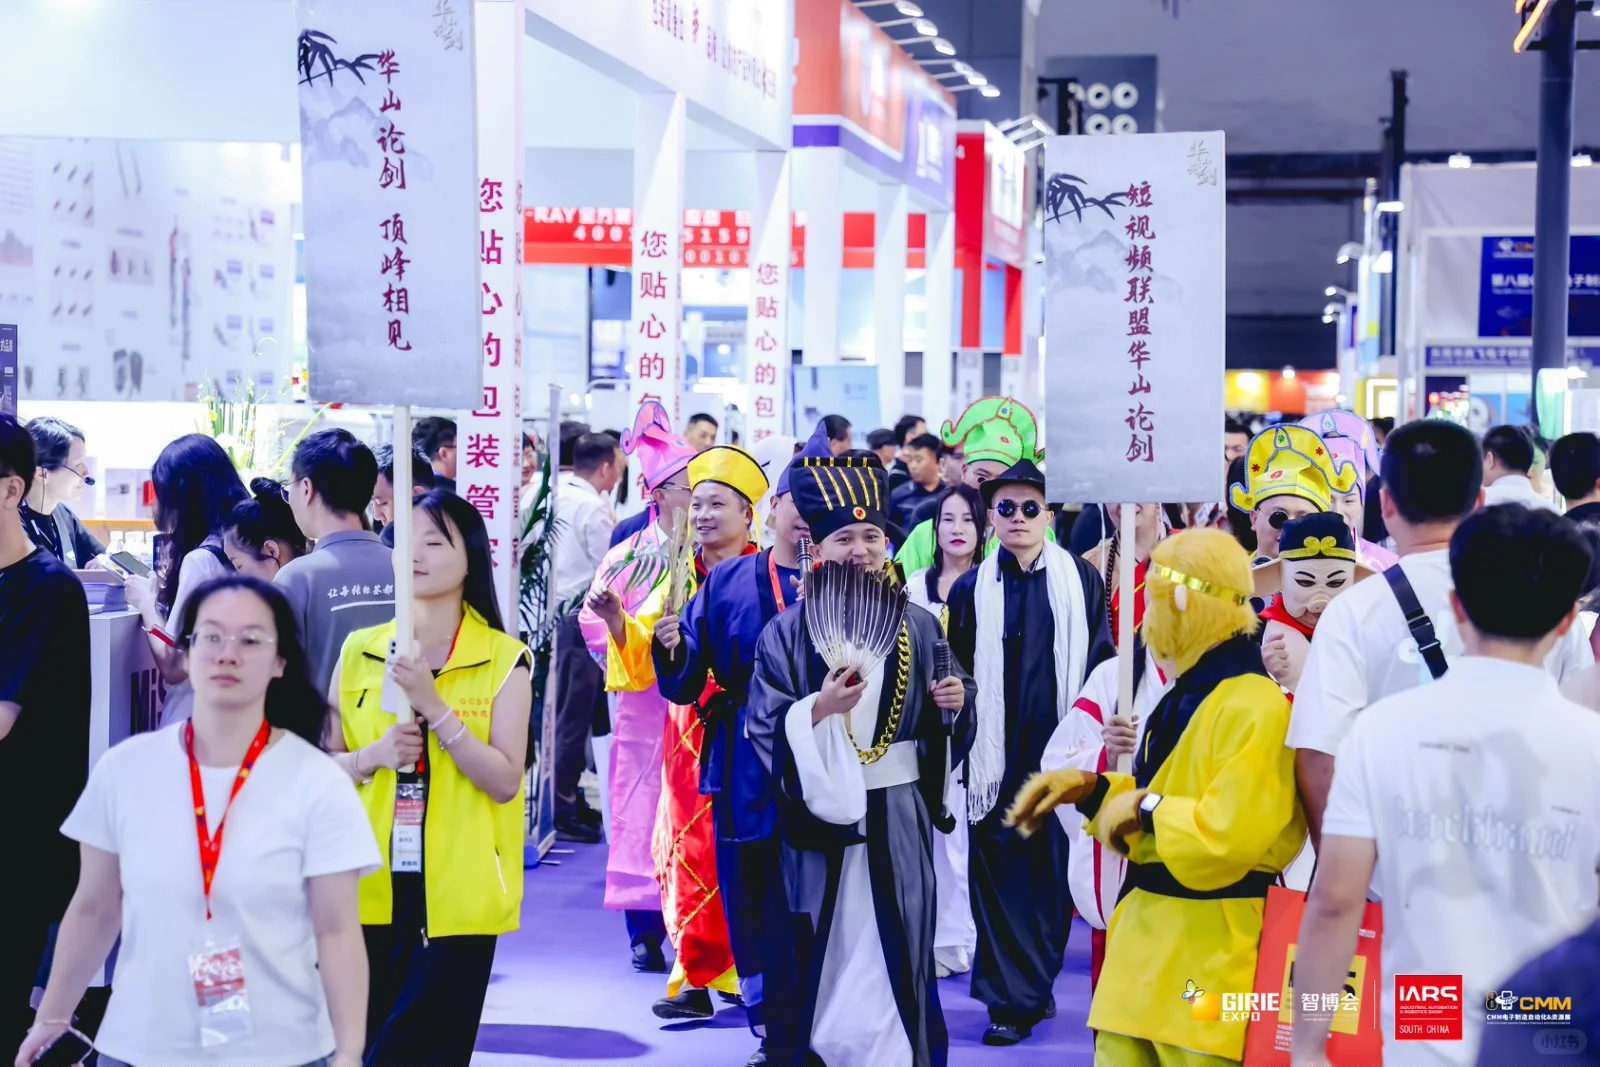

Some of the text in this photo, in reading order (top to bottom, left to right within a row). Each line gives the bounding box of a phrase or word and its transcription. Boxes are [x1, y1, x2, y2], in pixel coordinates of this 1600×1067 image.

[376, 48, 412, 352] 华山论剑 顶峰相见
[1123, 180, 1156, 463] 短视频联盟华山论剑
